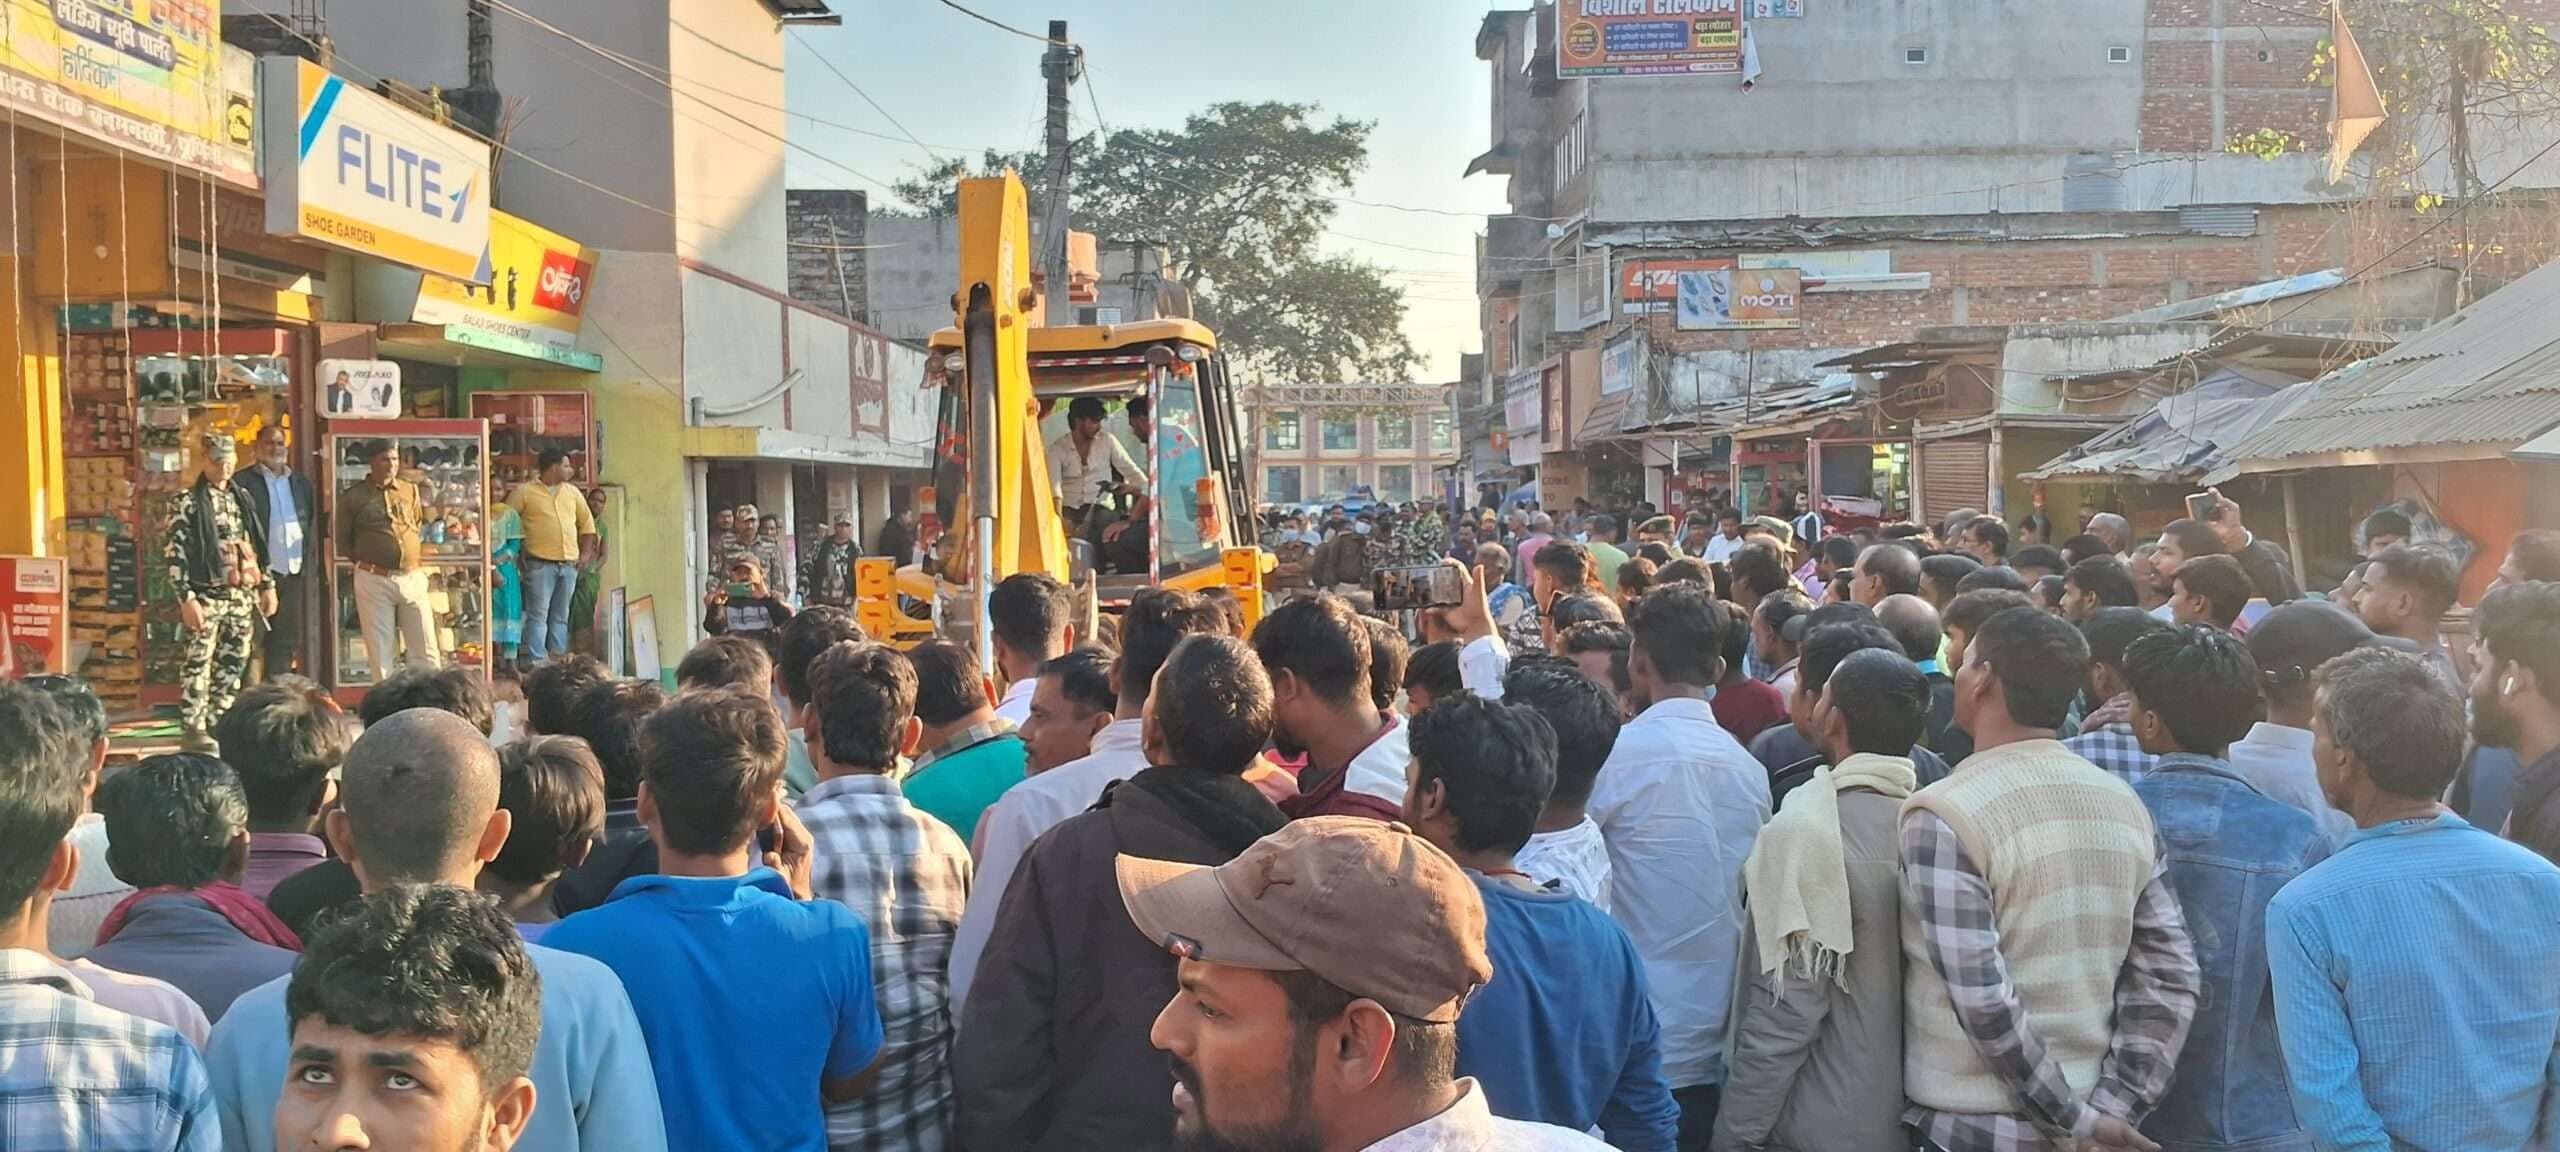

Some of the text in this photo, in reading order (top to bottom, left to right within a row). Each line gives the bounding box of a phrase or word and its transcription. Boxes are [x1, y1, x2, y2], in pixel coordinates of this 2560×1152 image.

[338, 124, 443, 219] FLITE
[305, 213, 376, 245] SHOE GARDEN
[1740, 294, 1794, 307] MOTI
